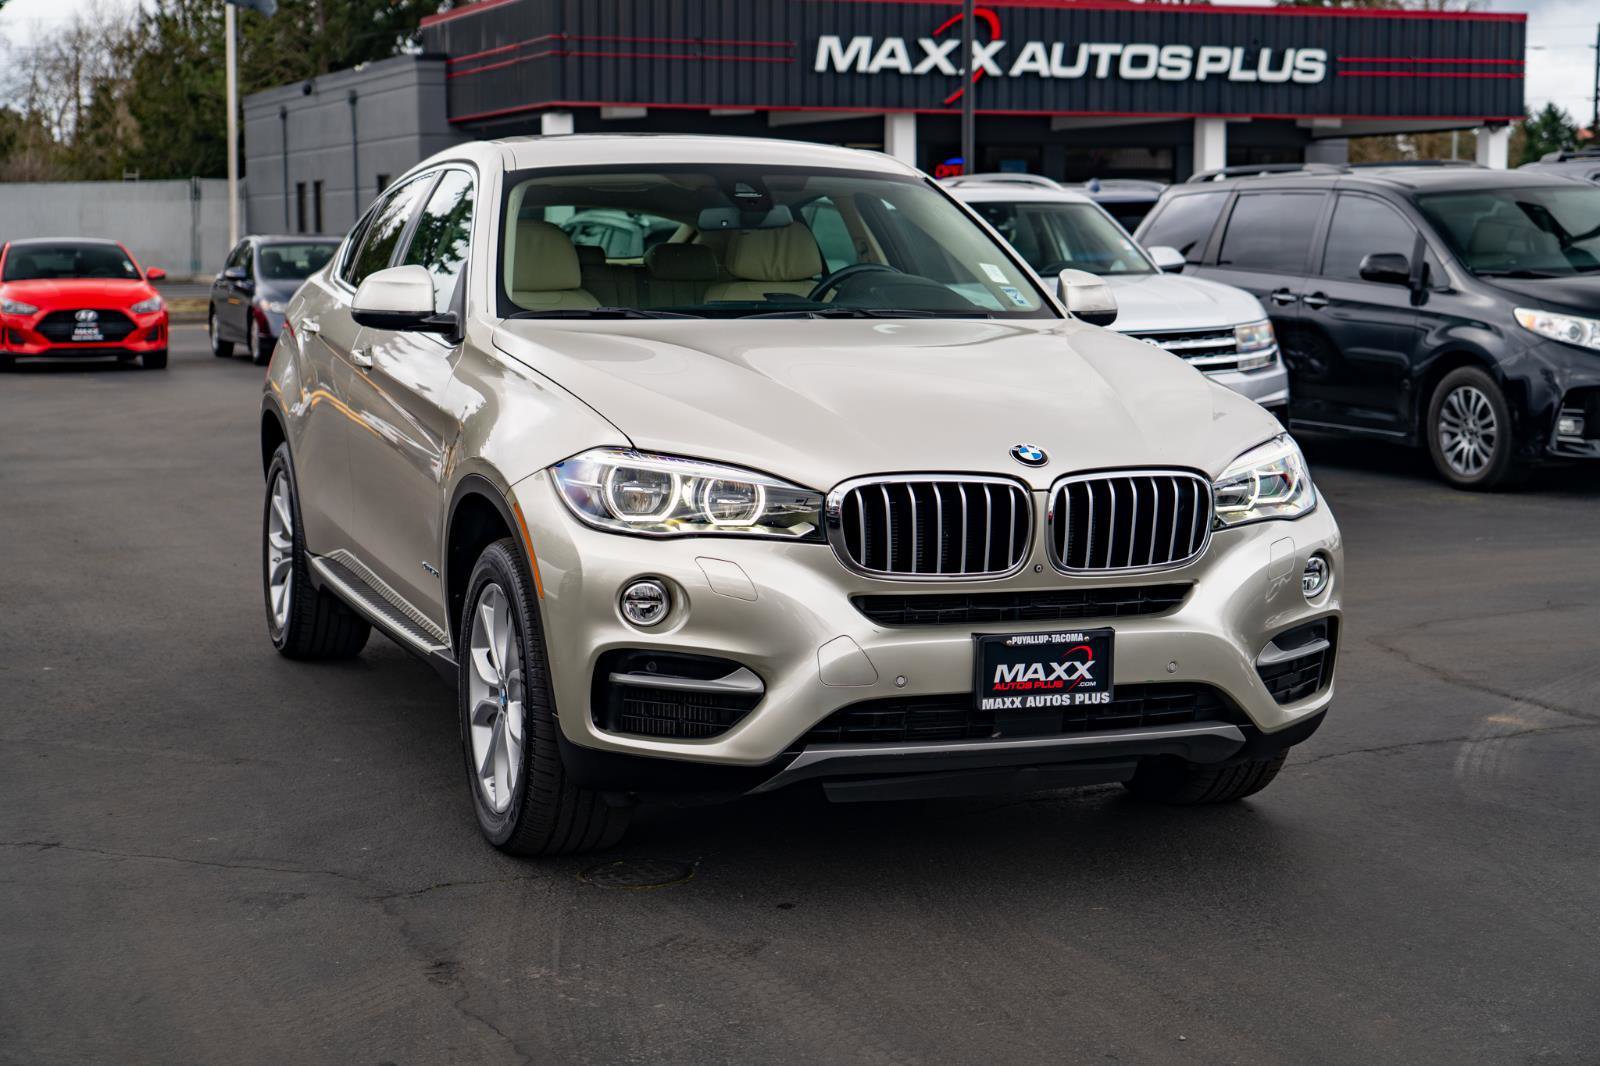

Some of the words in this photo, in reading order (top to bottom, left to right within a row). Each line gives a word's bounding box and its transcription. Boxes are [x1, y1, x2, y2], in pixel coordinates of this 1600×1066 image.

[815, 35, 1005, 77] MAXX
[1009, 41, 1193, 80] AUTOS
[1195, 46, 1328, 83] PLUS
[993, 660, 1096, 683] MAXX
[992, 681, 1032, 690] AUTOS
[1034, 680, 1064, 688] PLUS
[982, 697, 1022, 710] MAXX
[1026, 694, 1071, 708] AUTOS
[1075, 692, 1110, 704] PLUS
